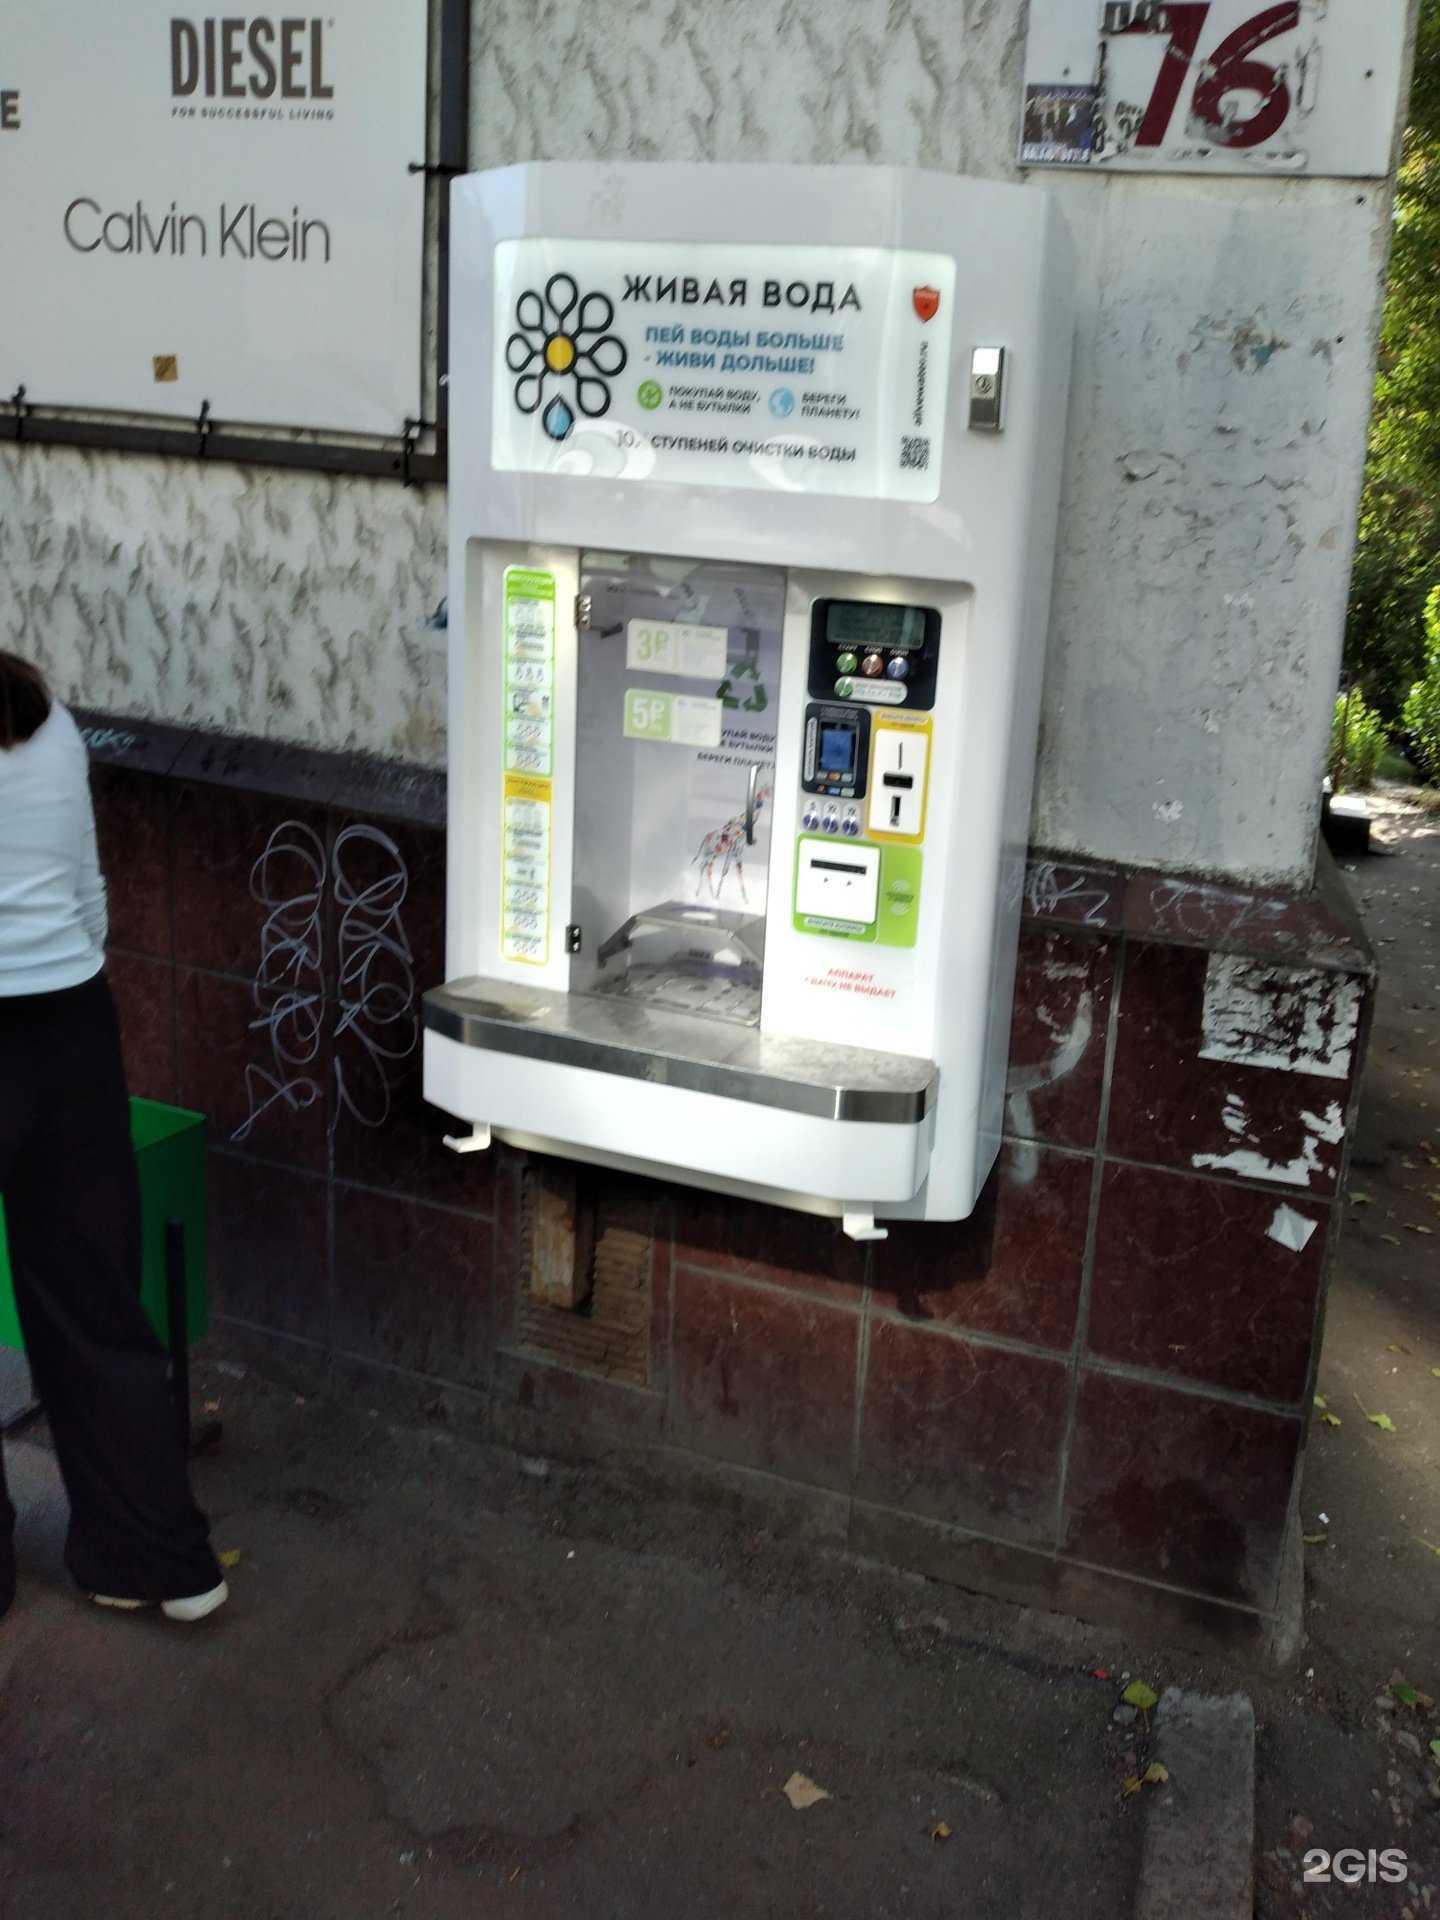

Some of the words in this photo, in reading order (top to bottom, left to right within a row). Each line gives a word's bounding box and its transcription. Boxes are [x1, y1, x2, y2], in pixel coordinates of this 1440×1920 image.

[170, 17, 334, 99] DIESEL
[171, 106, 196, 119] FOR
[200, 105, 285, 121] SUCCESSFUL
[288, 107, 334, 121] LIVING
[64, 197, 207, 258] Calvin
[220, 203, 331, 263] Klein
[622, 274, 748, 306] ЖИВАЯ
[762, 280, 862, 315] ВОДА
[644, 323, 685, 344] ПЕЙ
[690, 328, 750, 348] ВОДЫ
[756, 332, 844, 352] БОЛЬШЕ
[656, 350, 716, 369] ЖИВИ
[720, 353, 816, 375] ДОЛЬШЕ!
[668, 385, 725, 399] ПОКУПАЙ
[801, 391, 848, 405] БЕРЕГИ
[679, 401, 695, 412] НЕ
[696, 401, 751, 414] БУТЫЛКИ
[801, 405, 861, 421] ПЛАНЕТУ!
[650, 433, 729, 453] СТУПЕНЕЙ
[731, 439, 804, 457] ОЧИСТКИ
[808, 445, 856, 462] ВОДЫ
